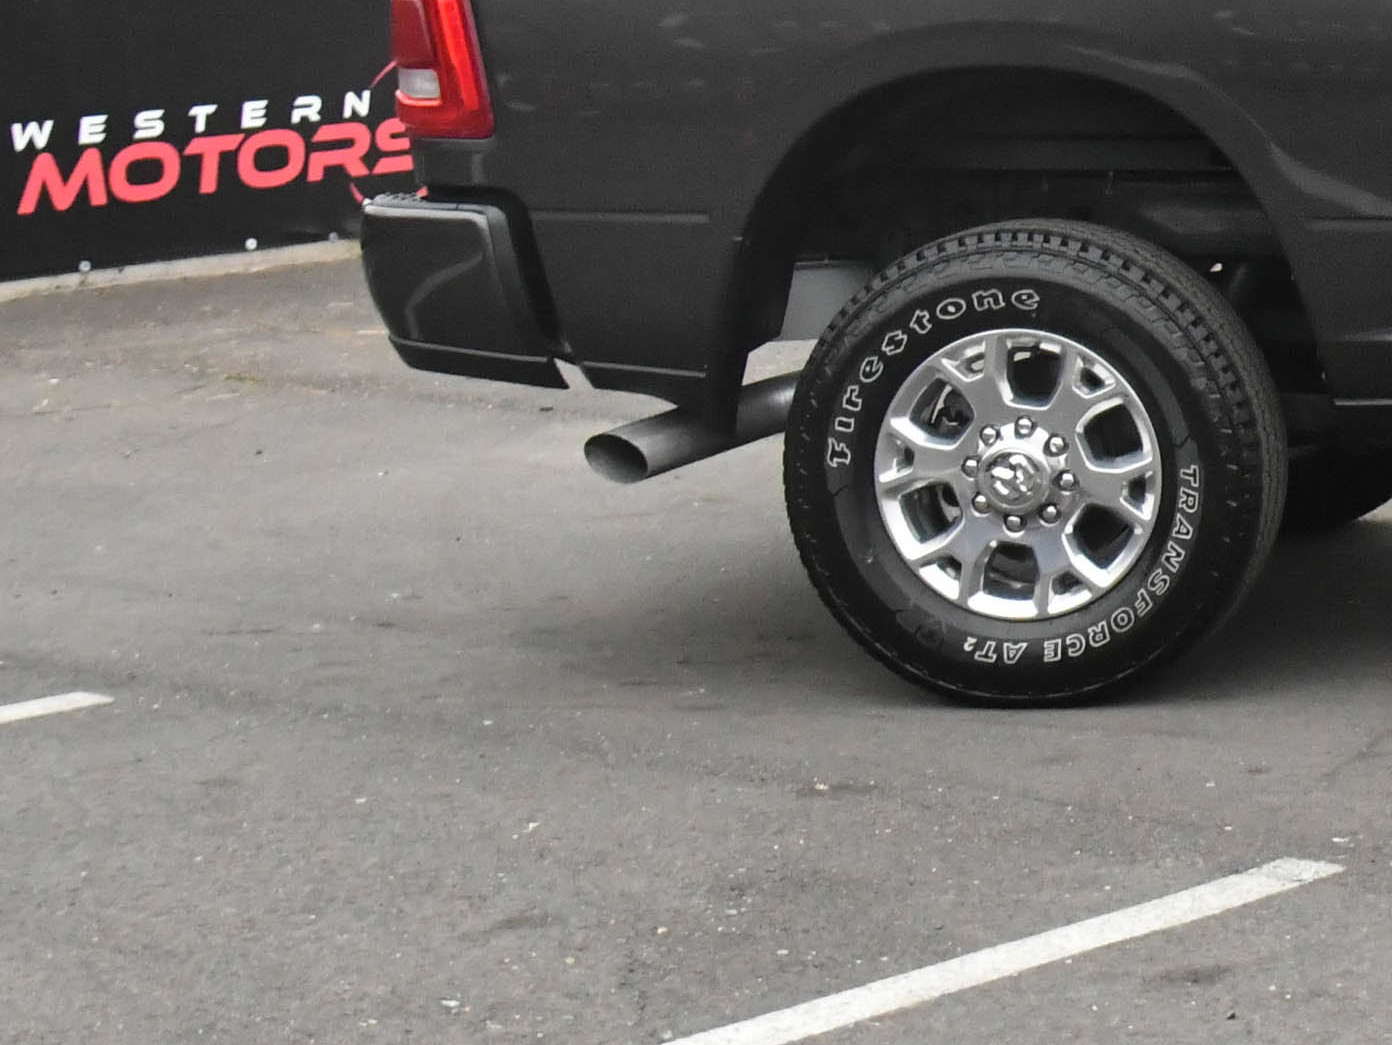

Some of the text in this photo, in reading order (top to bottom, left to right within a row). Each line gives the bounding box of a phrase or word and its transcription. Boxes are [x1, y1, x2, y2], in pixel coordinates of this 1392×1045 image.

[10, 89, 371, 151] WESTERN
[17, 118, 416, 215] MOTORS
[826, 288, 1041, 467] Firestone
[1044, 465, 1200, 663] TRANSFORCE
